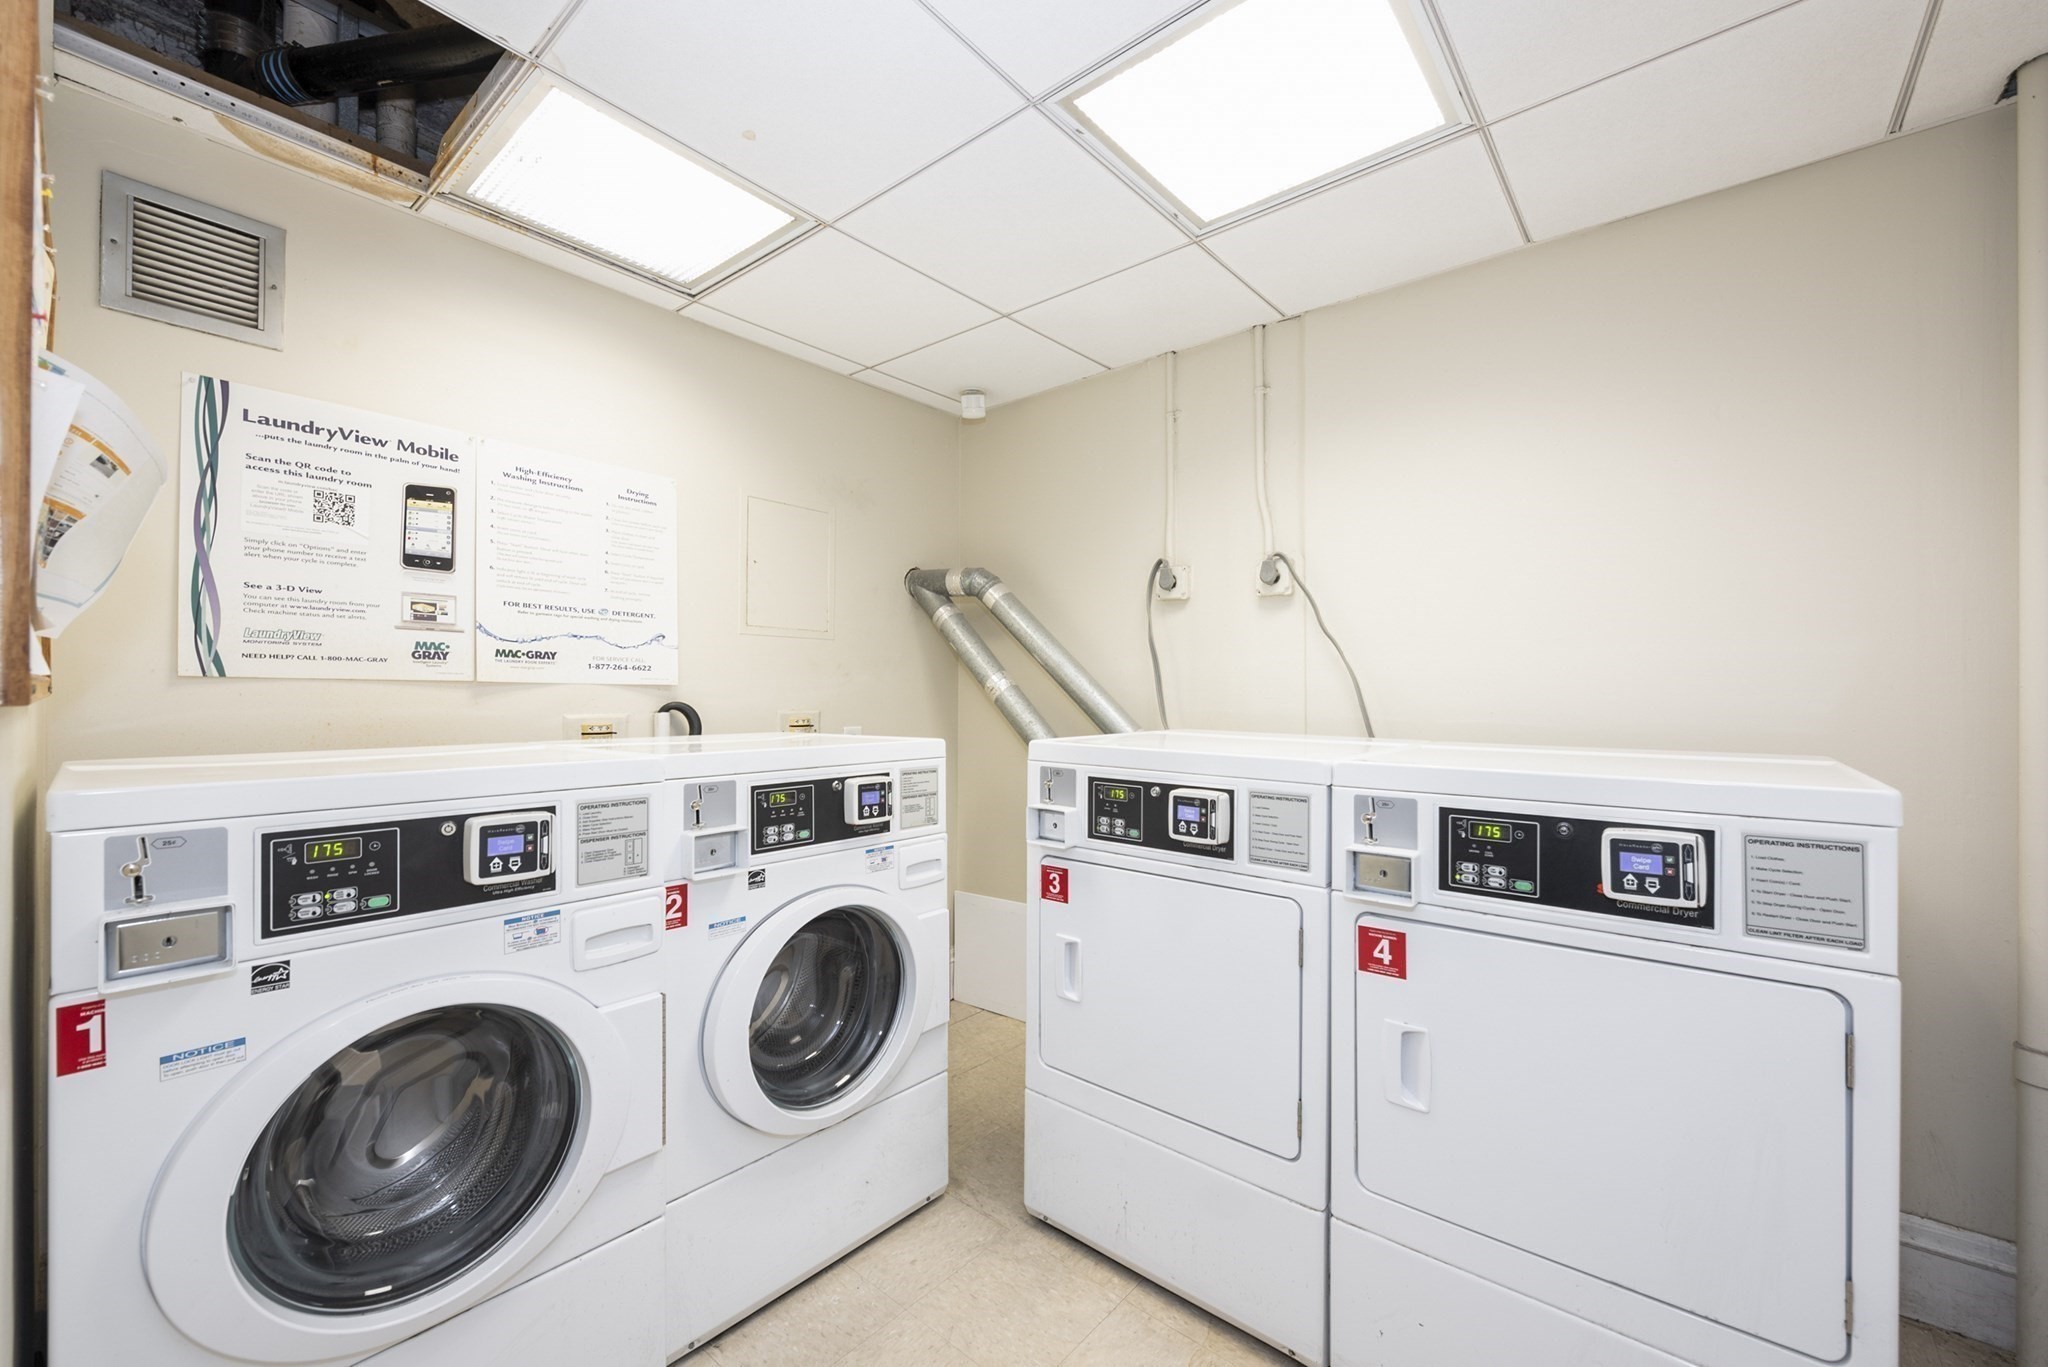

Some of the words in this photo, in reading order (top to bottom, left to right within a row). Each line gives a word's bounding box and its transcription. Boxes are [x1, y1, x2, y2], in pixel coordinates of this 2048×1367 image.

[243, 408, 388, 447] LaundryView
[397, 439, 459, 462] Mobile
[287, 437, 302, 445] the
[304, 440, 338, 452] laundry
[340, 447, 363, 456] room
[389, 457, 410, 465] palm
[439, 465, 461, 474] hand!
[245, 452, 271, 463] Scan
[274, 458, 292, 466] the
[295, 461, 312, 470] QR
[314, 466, 338, 474] code
[245, 463, 281, 474] access
[283, 469, 303, 478] this
[305, 471, 344, 485] laundry
[346, 480, 373, 488] room
[515, 466, 573, 483] High-Efficiency
[502, 471, 537, 485] Washing
[539, 479, 584, 492] Instructions
[617, 494, 657, 506] Instructions
[626, 488, 649, 499] Drying
[243, 537, 269, 547] Simply
[270, 539, 286, 547] click
[262, 546, 285, 554] phone
[286, 549, 314, 557] number
[243, 581, 263, 590] See
[275, 584, 295, 592] 3-D
[298, 586, 323, 594] View
[503, 600, 521, 608] FOR
[522, 602, 542, 610] BEST
[544, 604, 579, 614] RESULTS,
[611, 610, 656, 619] DETERGENT.
[243, 627, 322, 641] LaundryView
[320, 655, 388, 663] 1-800-MAC-GRAY
[411, 650, 450, 660] GRAY
[588, 663, 652, 672] 1-877-264-6622
[771, 793, 786, 803] 175
[1110, 789, 1124, 799] 175
[1275, 796, 1308, 804] INSTRUCTIONS
[580, 803, 610, 811] OPERATING
[610, 800, 647, 808] INSTRUCTIONS
[580, 836, 610, 845] DISPENSER
[610, 831, 647, 840] INSTRUCTIONS
[1477, 825, 1501, 838] 175
[313, 842, 343, 858] 175
[1211, 845, 1227, 853] Dryer
[1748, 838, 1794, 848] OPERATING
[1796, 842, 1860, 853] INSTRUCTIONS
[1631, 856, 1652, 864] Swipe
[1633, 863, 1650, 871] Card
[483, 880, 520, 892] Commercial
[521, 877, 543, 886] Washer
[1049, 872, 1060, 894] 3
[666, 893, 683, 919] 2
[1616, 900, 1670, 915] Commercial
[1672, 907, 1699, 919] Dryer
[521, 913, 545, 922] NOTICE
[713, 916, 742, 929] NOTICE
[1783, 931, 1804, 939] FILTER
[1805, 934, 1825, 942] AFTER
[1844, 939, 1863, 947] LOAD
[1373, 938, 1393, 966] 4
[76, 1014, 102, 1054] 1
[172, 1041, 235, 1061] NOTICE
[162, 1060, 180, 1069] DOOR
[180, 1057, 196, 1065] LOCK
